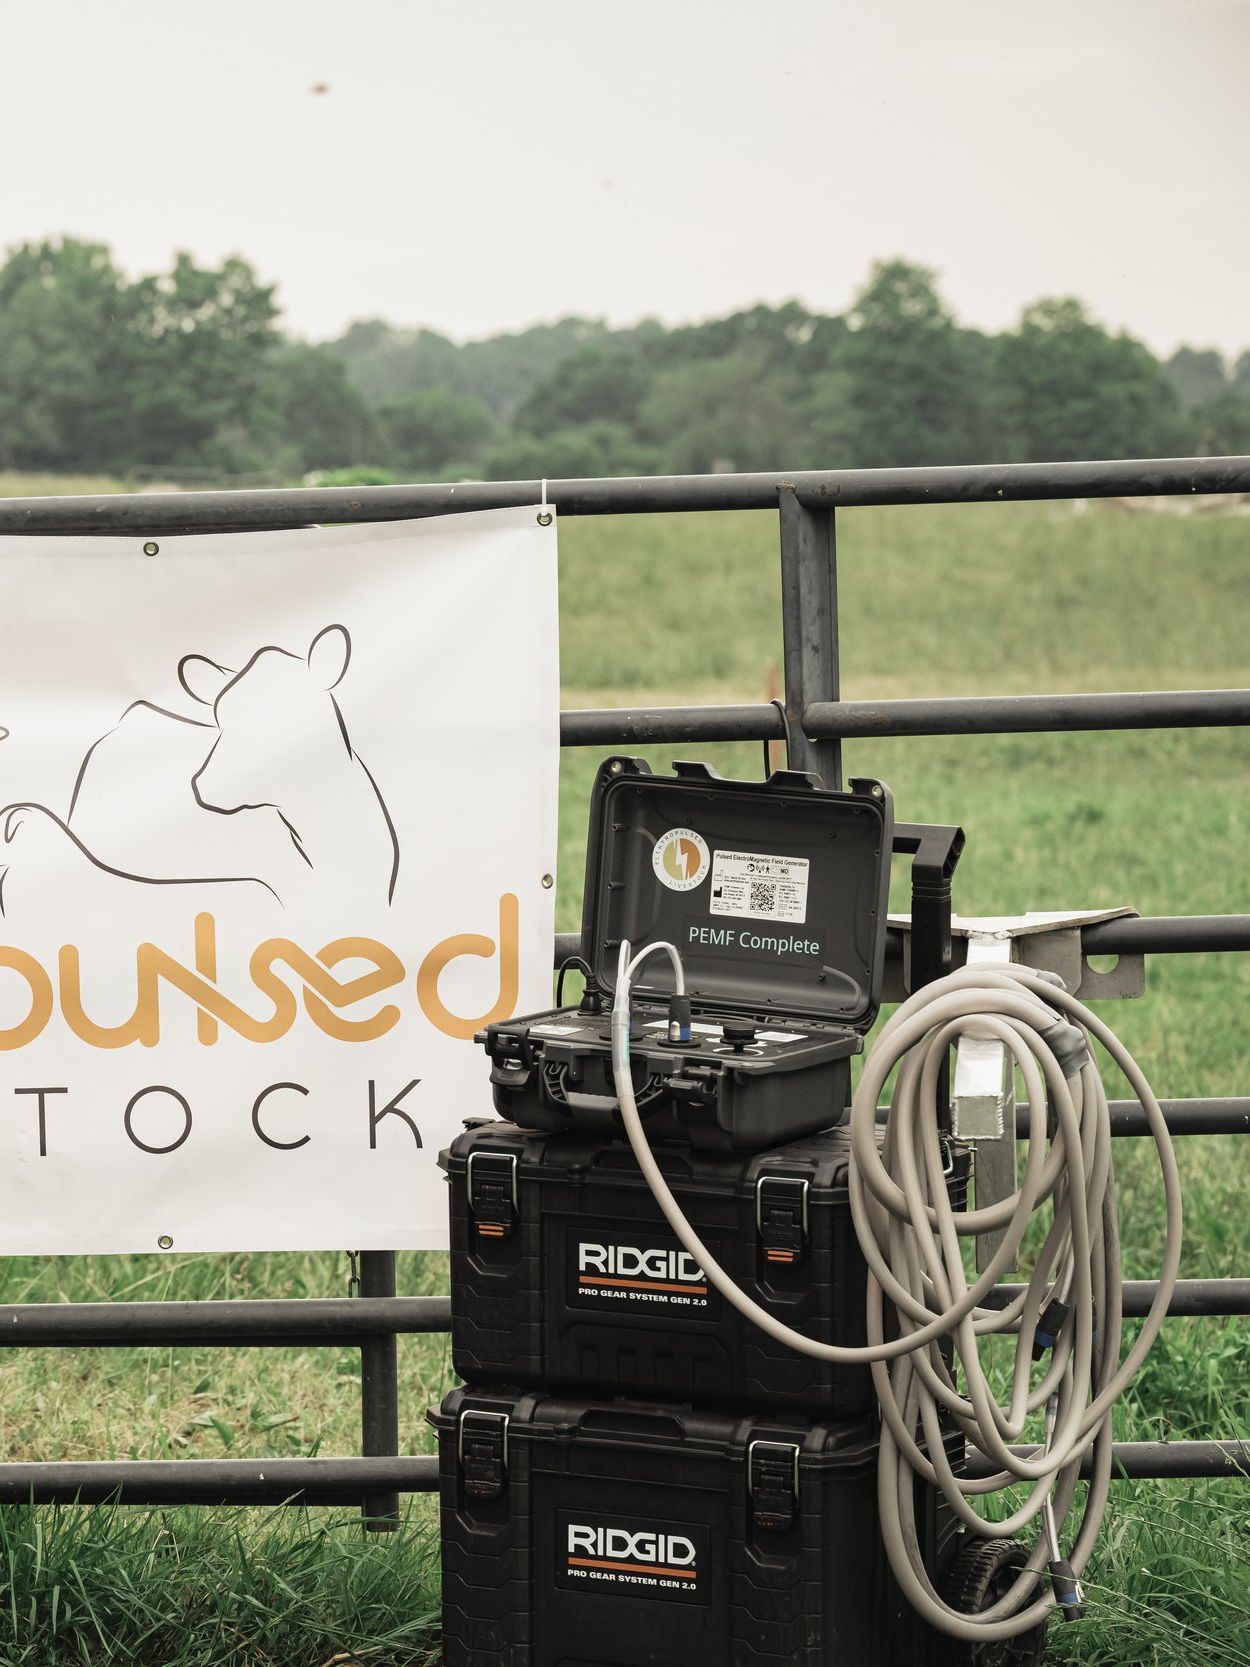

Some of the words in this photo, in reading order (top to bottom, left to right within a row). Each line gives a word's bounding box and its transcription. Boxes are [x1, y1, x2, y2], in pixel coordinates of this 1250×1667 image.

[716, 853, 732, 861] Pulsed
[733, 854, 771, 864] ElectroMagnetic
[784, 859, 808, 867] Generator
[689, 926, 736, 946] PEMF
[739, 931, 820, 956] Complete
[578, 1287, 598, 1296] PRO
[600, 1289, 627, 1299] GEAR
[629, 1292, 668, 1303] SYSTEM
[670, 1296, 691, 1305] GEN
[692, 1298, 708, 1306] 2.0
[568, 1524, 696, 1566] RIDGID
[567, 1569, 587, 1578] PRO
[589, 1571, 616, 1581] GEAR
[618, 1574, 657, 1586] SYSTEM
[659, 1579, 680, 1588] GEN
[681, 1582, 697, 1590] 2.0
